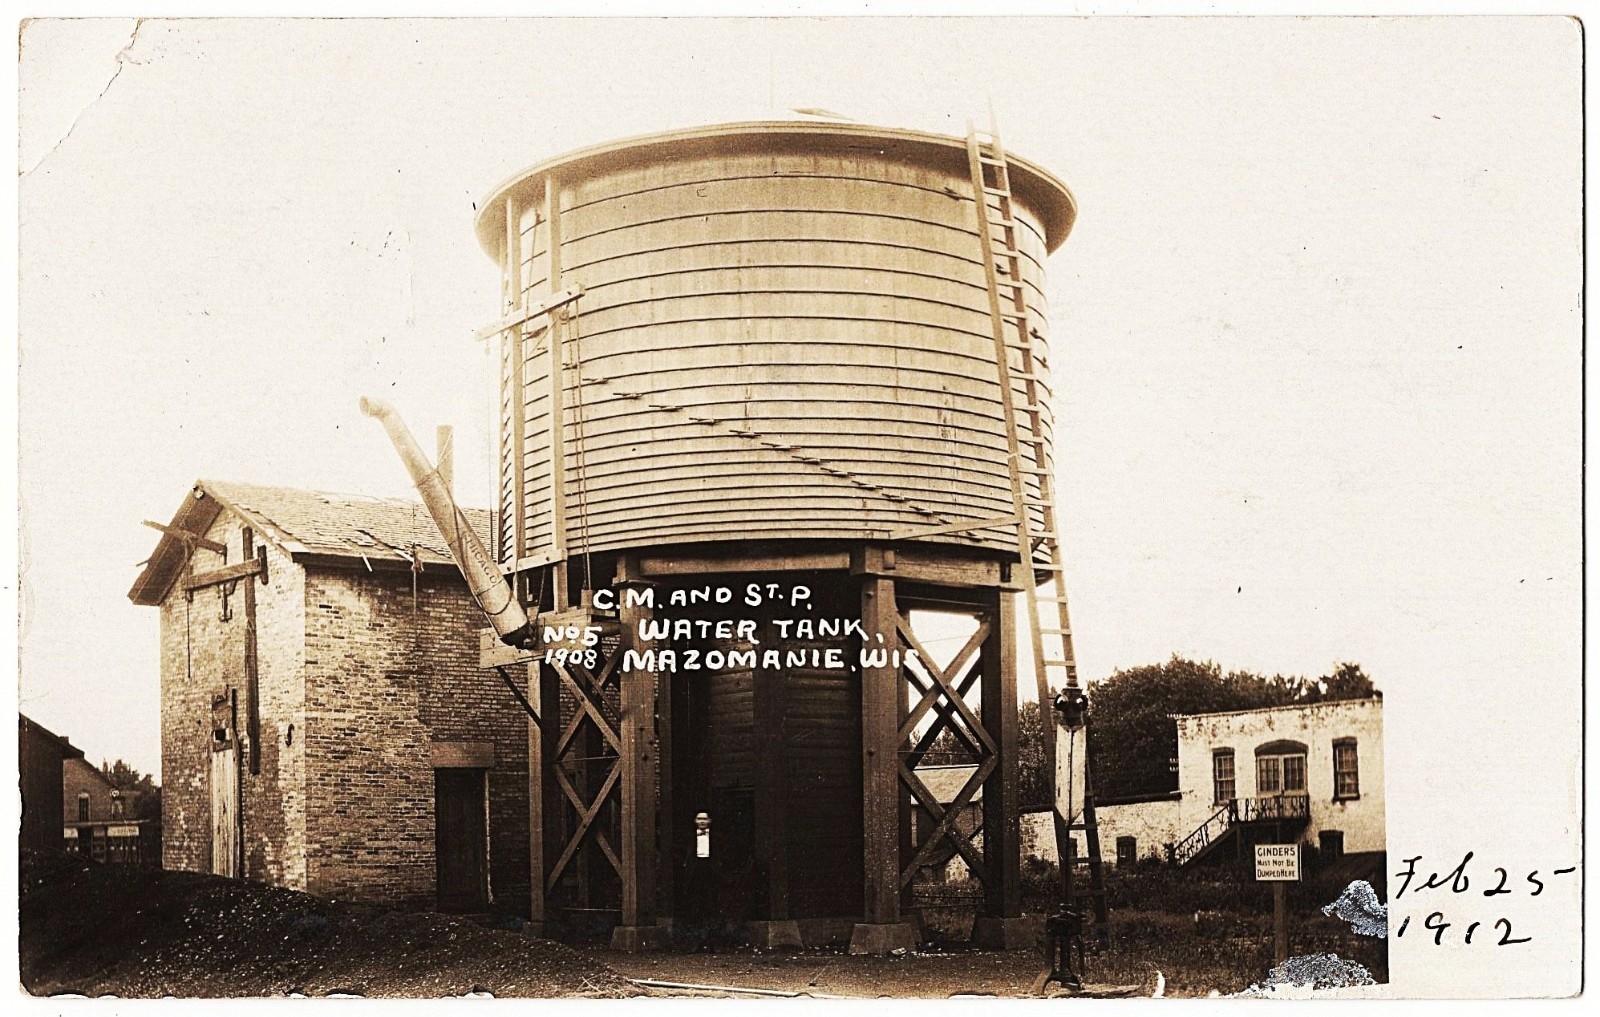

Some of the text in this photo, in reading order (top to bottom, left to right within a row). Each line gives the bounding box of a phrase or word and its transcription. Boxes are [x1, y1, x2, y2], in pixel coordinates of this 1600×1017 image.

[1257, 847, 1296, 857] CINDERS
[1395, 851, 1474, 899] Feb
[1397, 911, 1532, 945] 1912
